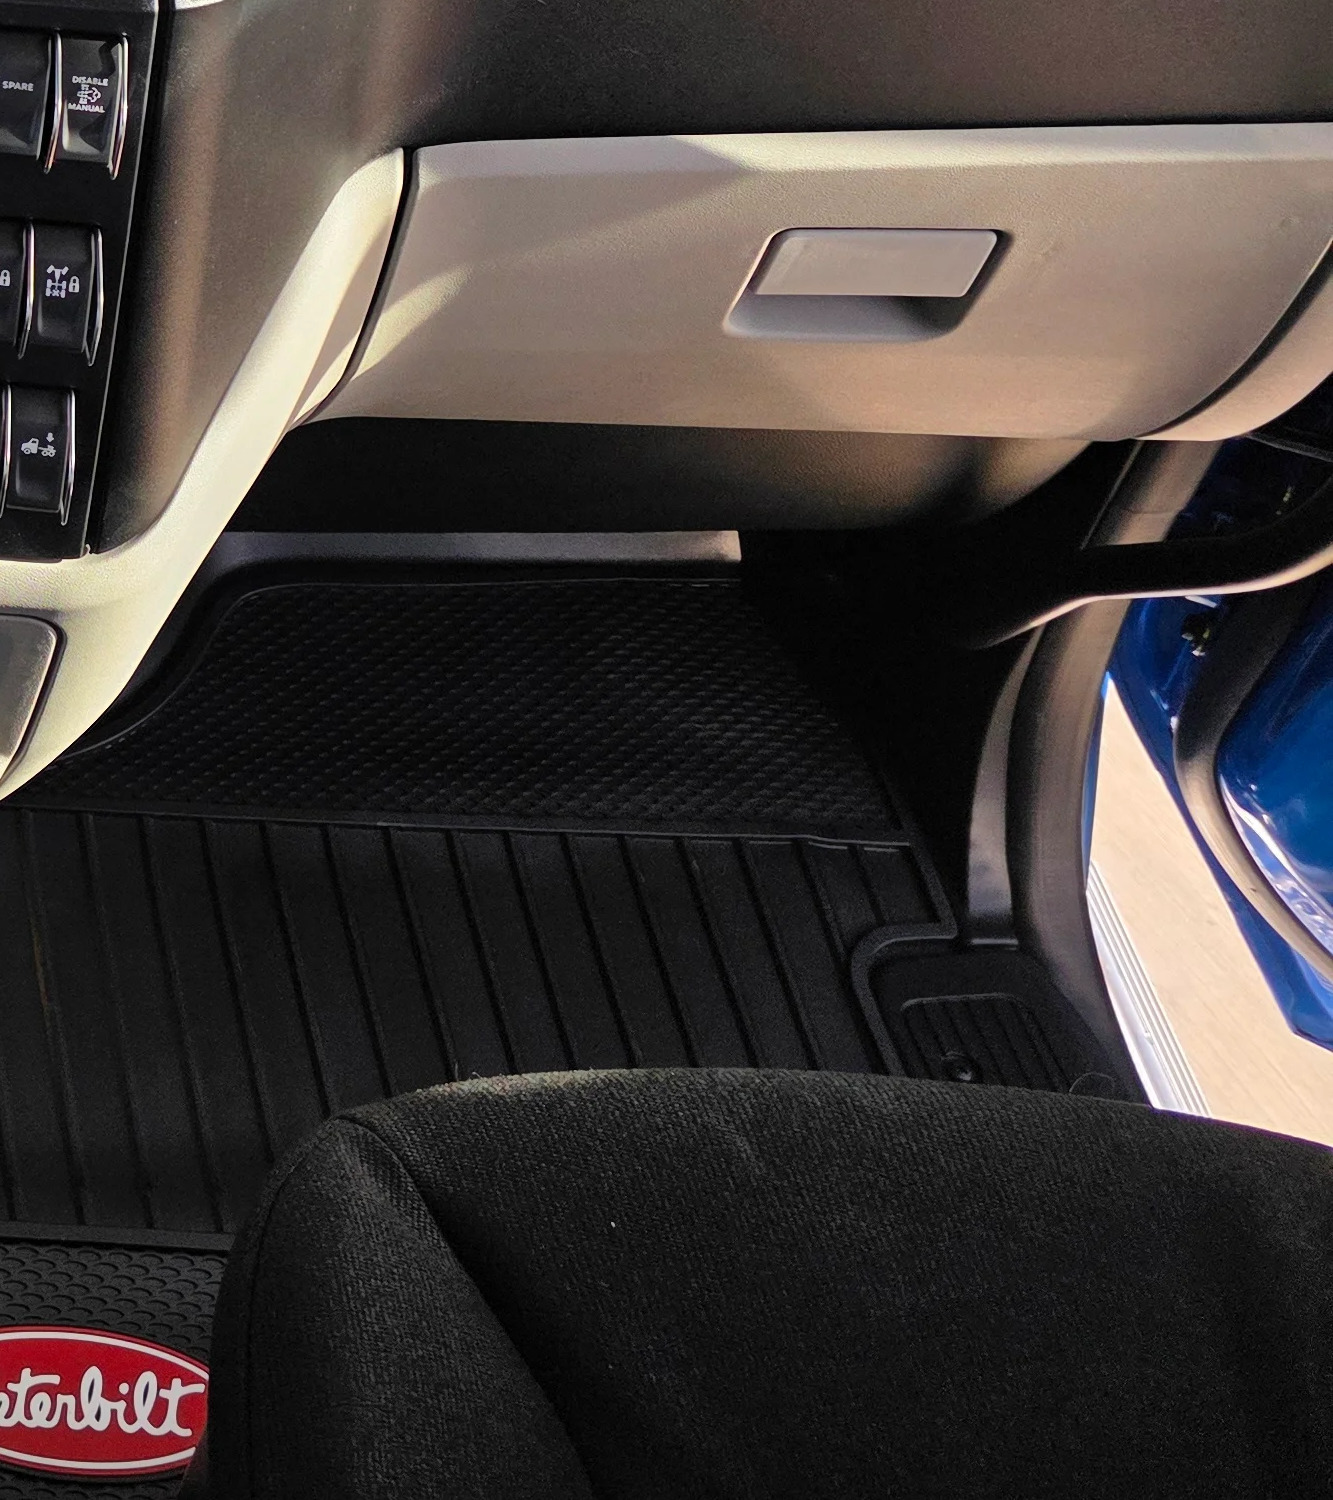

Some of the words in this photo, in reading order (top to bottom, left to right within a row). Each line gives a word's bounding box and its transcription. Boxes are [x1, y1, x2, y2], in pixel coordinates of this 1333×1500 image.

[2, 80, 34, 91] SPARE
[72, 76, 109, 86] DISABLE
[68, 103, 105, 113] MANUAL
